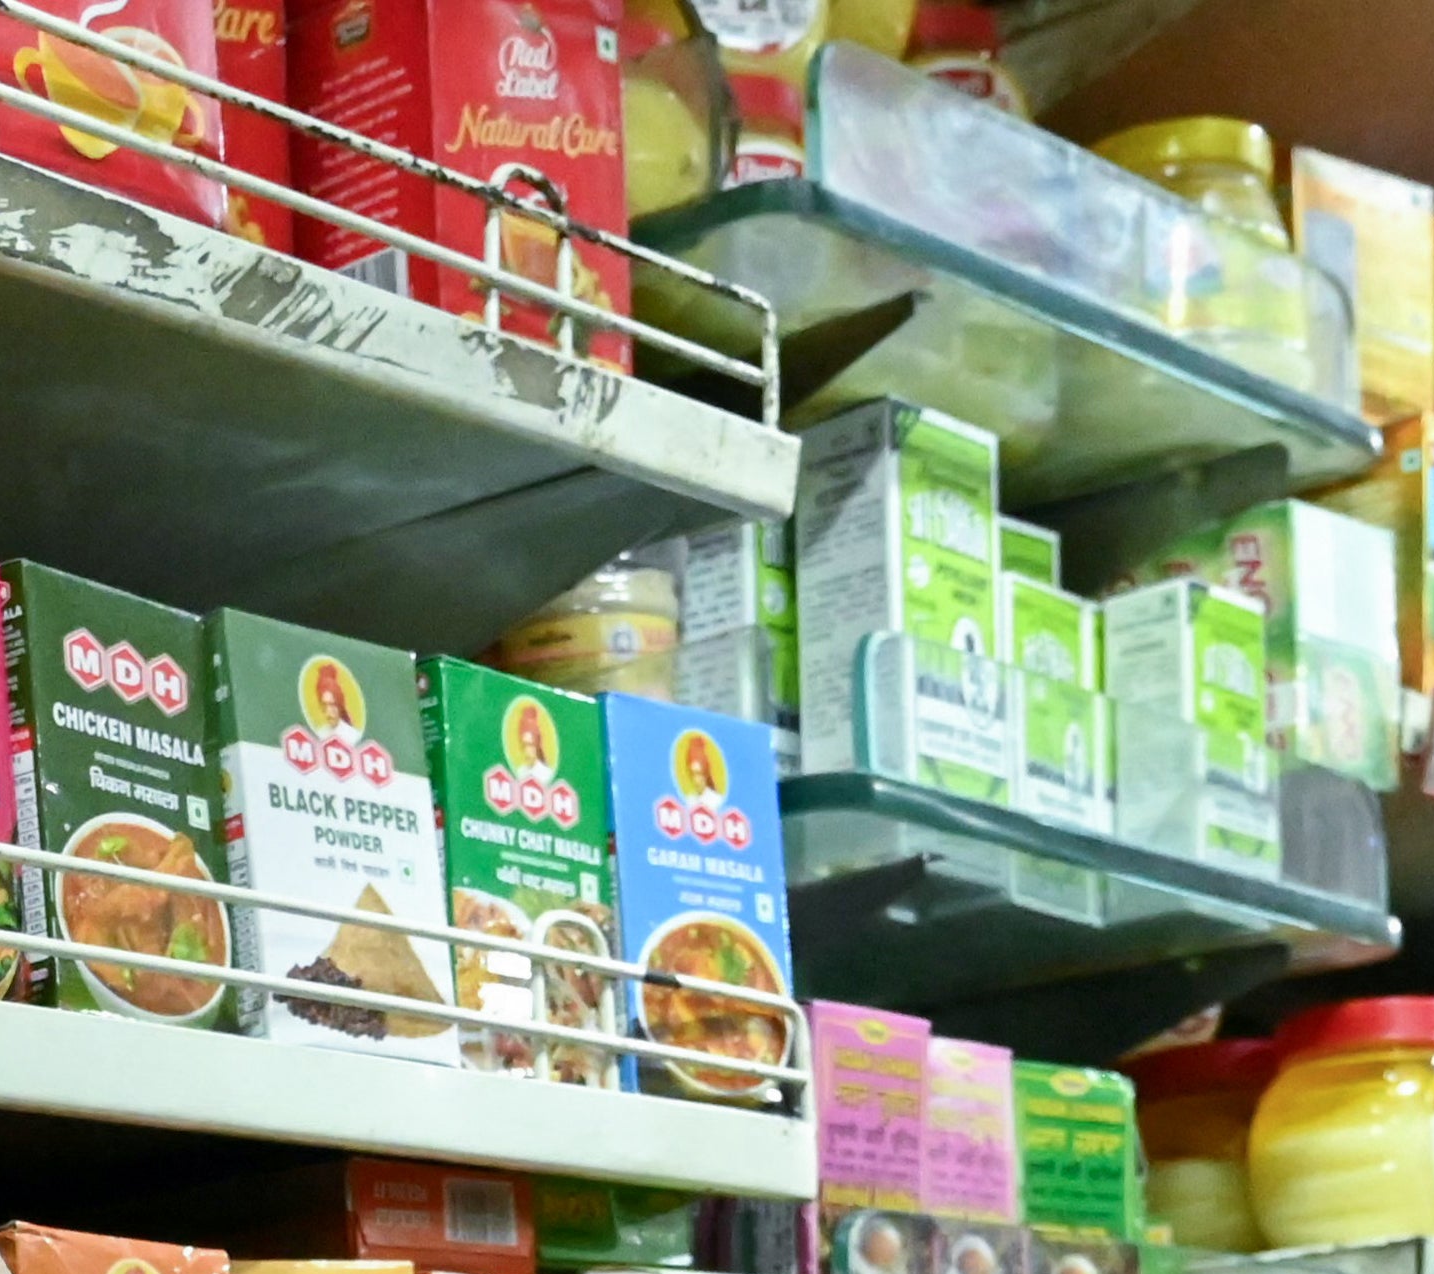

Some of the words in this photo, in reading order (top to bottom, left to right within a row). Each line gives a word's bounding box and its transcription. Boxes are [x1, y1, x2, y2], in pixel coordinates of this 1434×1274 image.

[510, 37, 552, 70] Red
[498, 68, 560, 99] Label
[447, 104, 558, 156] Natural
[564, 112, 619, 157] Care
[52, 702, 133, 747] CHICKEN
[135, 727, 206, 768] MASALA
[268, 782, 338, 821] BLACK
[343, 799, 420, 835] PEPPER
[314, 826, 384, 855] POWDER
